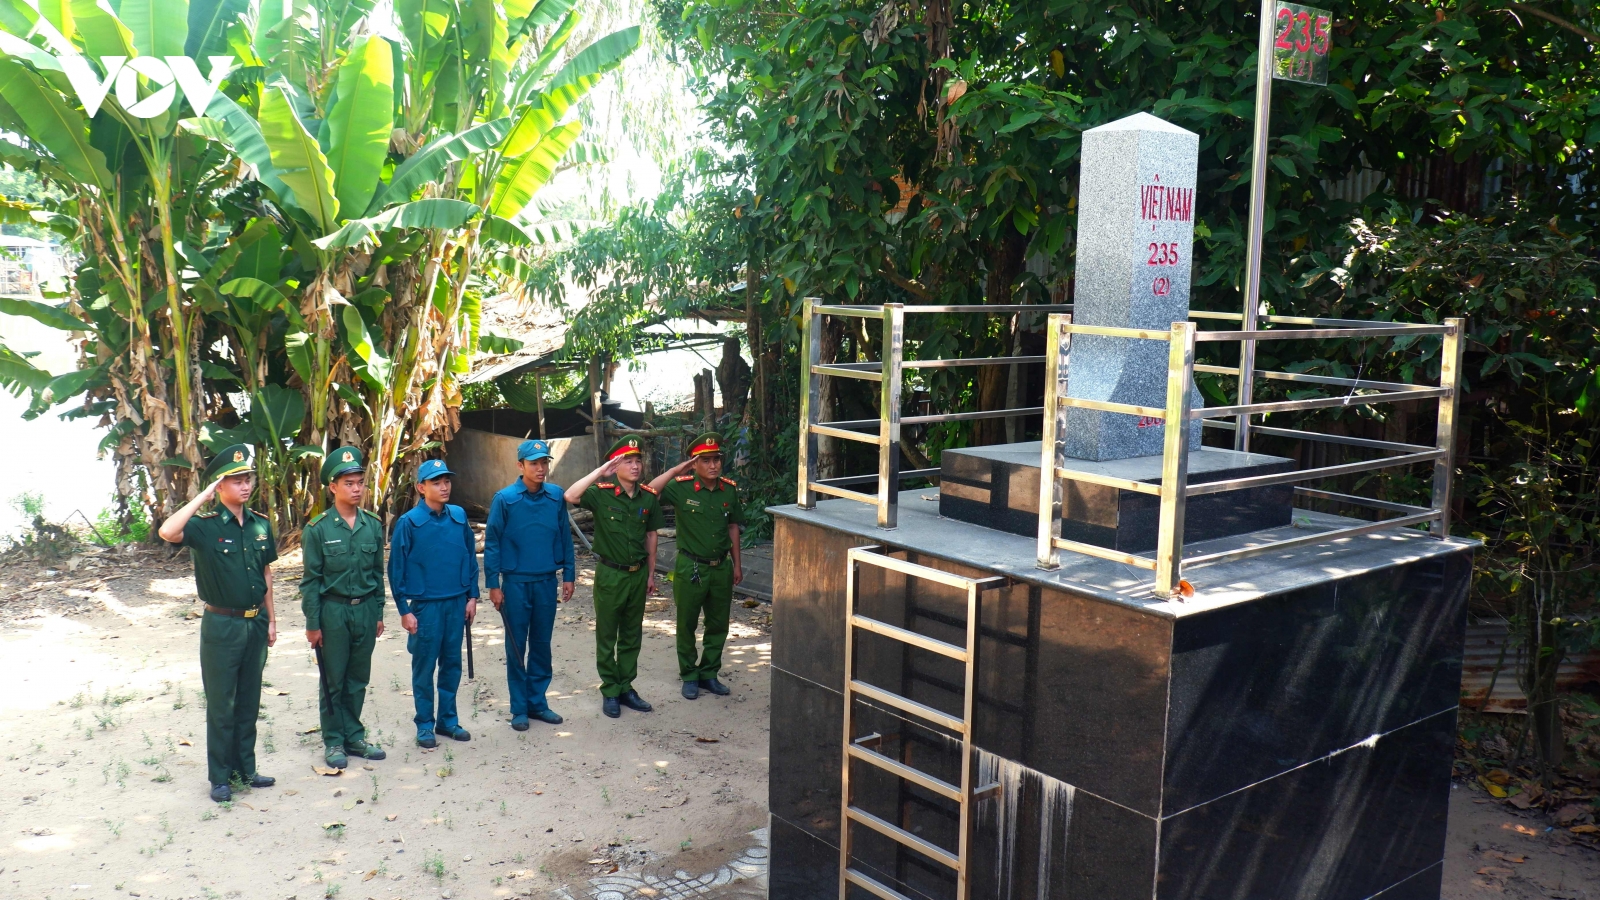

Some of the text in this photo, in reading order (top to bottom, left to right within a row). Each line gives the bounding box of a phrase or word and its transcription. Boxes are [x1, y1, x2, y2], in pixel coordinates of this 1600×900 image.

[1274, 8, 1329, 56] 235
[1289, 57, 1313, 80] (2)
[1141, 173, 1193, 231] VIỆT NAM
[1147, 242, 1178, 266] 235
[1153, 277, 1170, 296] (2)
[1138, 415, 1166, 428] 200
